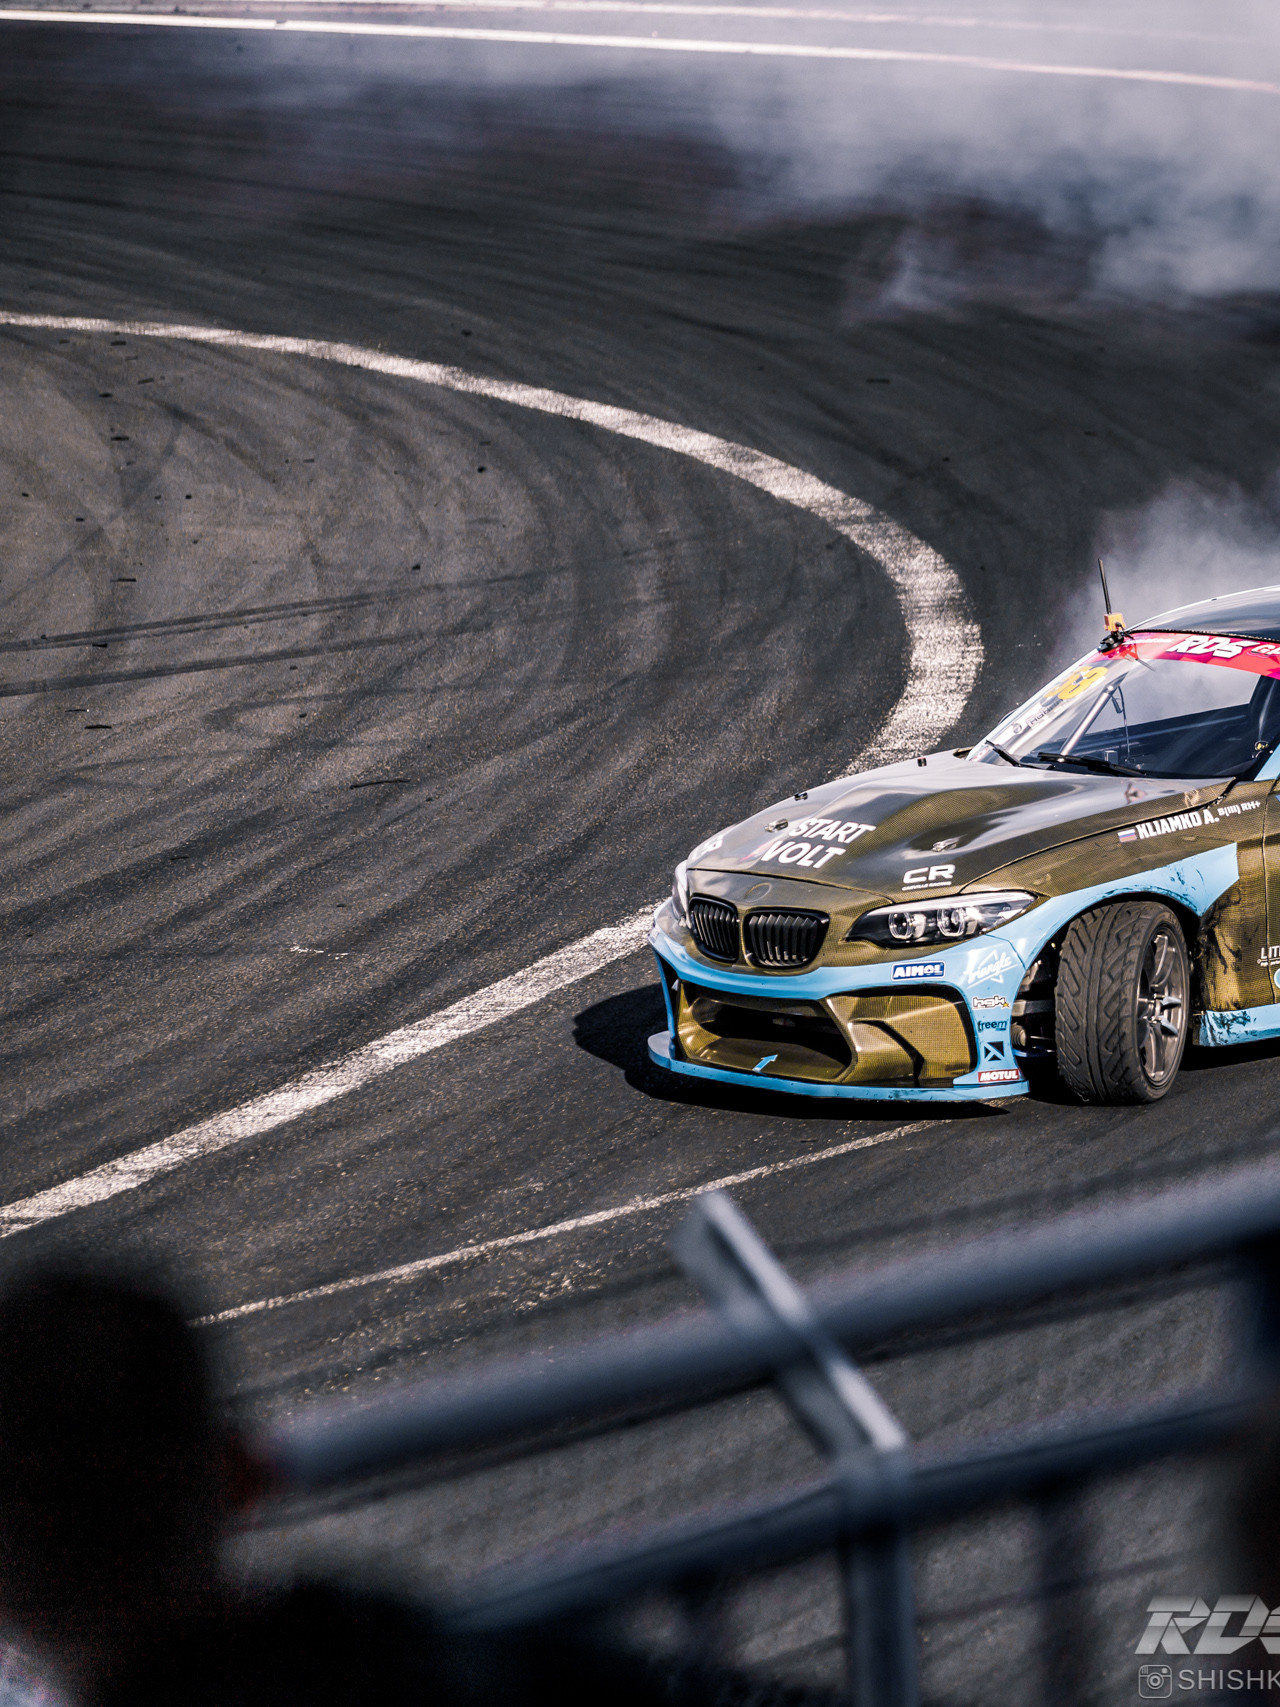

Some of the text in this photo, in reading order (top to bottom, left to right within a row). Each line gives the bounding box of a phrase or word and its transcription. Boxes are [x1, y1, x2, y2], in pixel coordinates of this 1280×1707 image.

[1165, 635, 1260, 658] RDS
[788, 817, 876, 843] START
[1135, 811, 1203, 839] KLIAMKO
[1203, 808, 1220, 825] A.
[1241, 800, 1261, 812] RH+
[760, 841, 846, 869] VOLT
[903, 864, 956, 884] CR
[893, 965, 943, 978] AIMOL
[977, 1020, 1007, 1033] freem
[980, 1070, 1018, 1081] MOTUL
